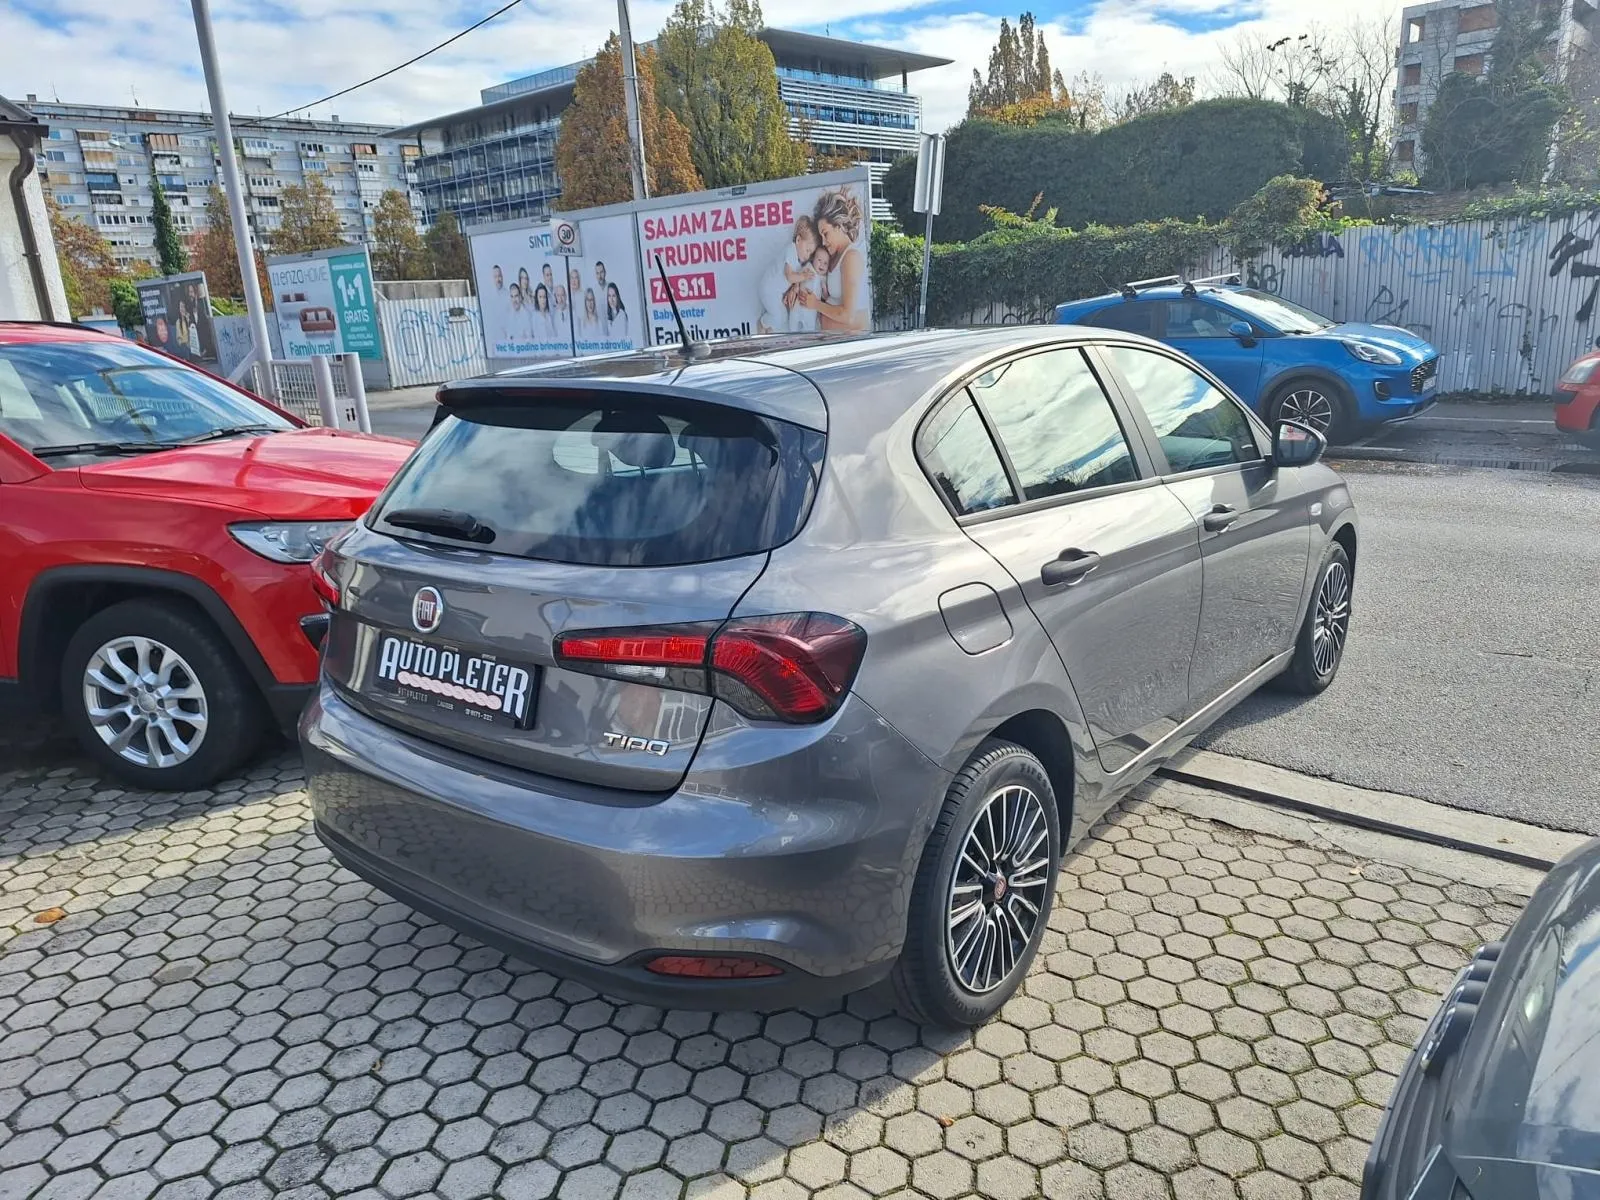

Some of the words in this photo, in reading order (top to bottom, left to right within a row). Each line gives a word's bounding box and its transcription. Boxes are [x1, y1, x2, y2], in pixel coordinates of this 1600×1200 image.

[644, 211, 707, 241] SAJAM
[710, 207, 737, 233] ZA
[740, 200, 794, 229] BEBE
[561, 229, 571, 240] 30
[559, 246, 576, 254] ZONA
[646, 249, 652, 269] I
[653, 237, 748, 269] TRUDNICE
[337, 273, 366, 308] 1+1
[677, 277, 711, 298] 9.11.
[343, 309, 370, 324] GRATIS
[655, 323, 709, 346] Family
[713, 321, 750, 339] mall
[289, 340, 317, 356] Family
[318, 341, 336, 354] mall
[495, 343, 507, 352] Već
[515, 342, 539, 354] godina
[540, 342, 568, 351] brinemo
[575, 340, 599, 350] Vašem
[600, 339, 633, 350] zdravlju!
[417, 600, 436, 621] FIAT
[603, 732, 670, 756] TIPO
